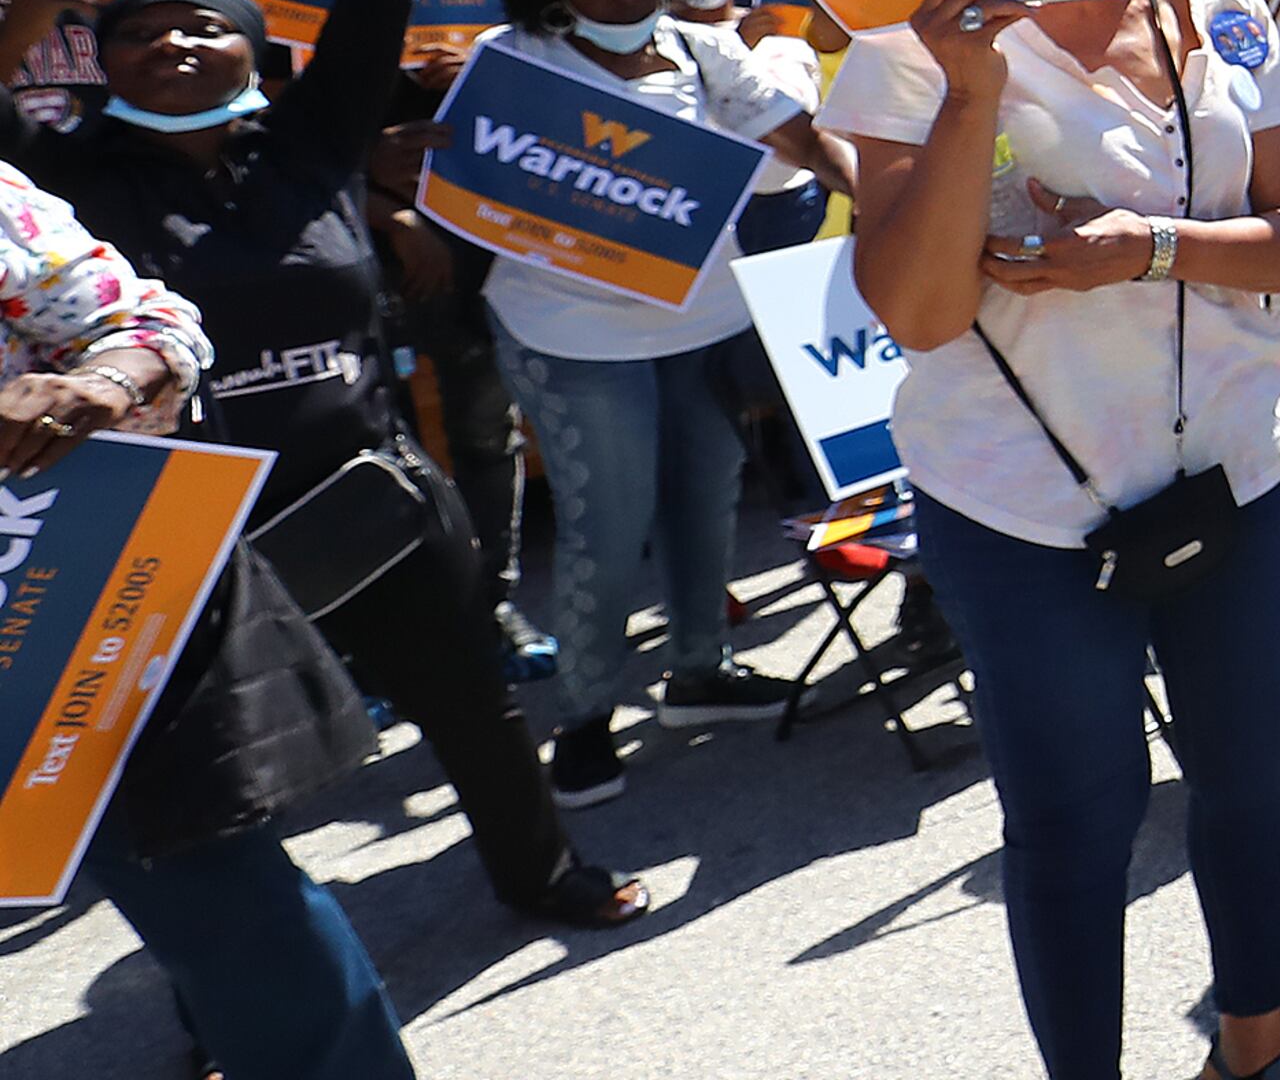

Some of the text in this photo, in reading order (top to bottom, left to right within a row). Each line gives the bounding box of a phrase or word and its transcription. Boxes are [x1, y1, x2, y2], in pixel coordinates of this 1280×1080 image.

[473, 116, 701, 227] Warnock
[801, 329, 902, 377] Wa
[102, 556, 161, 632] 52005
[89, 635, 126, 664] to
[55, 670, 106, 728] JOIN
[24, 731, 81, 789] Text
